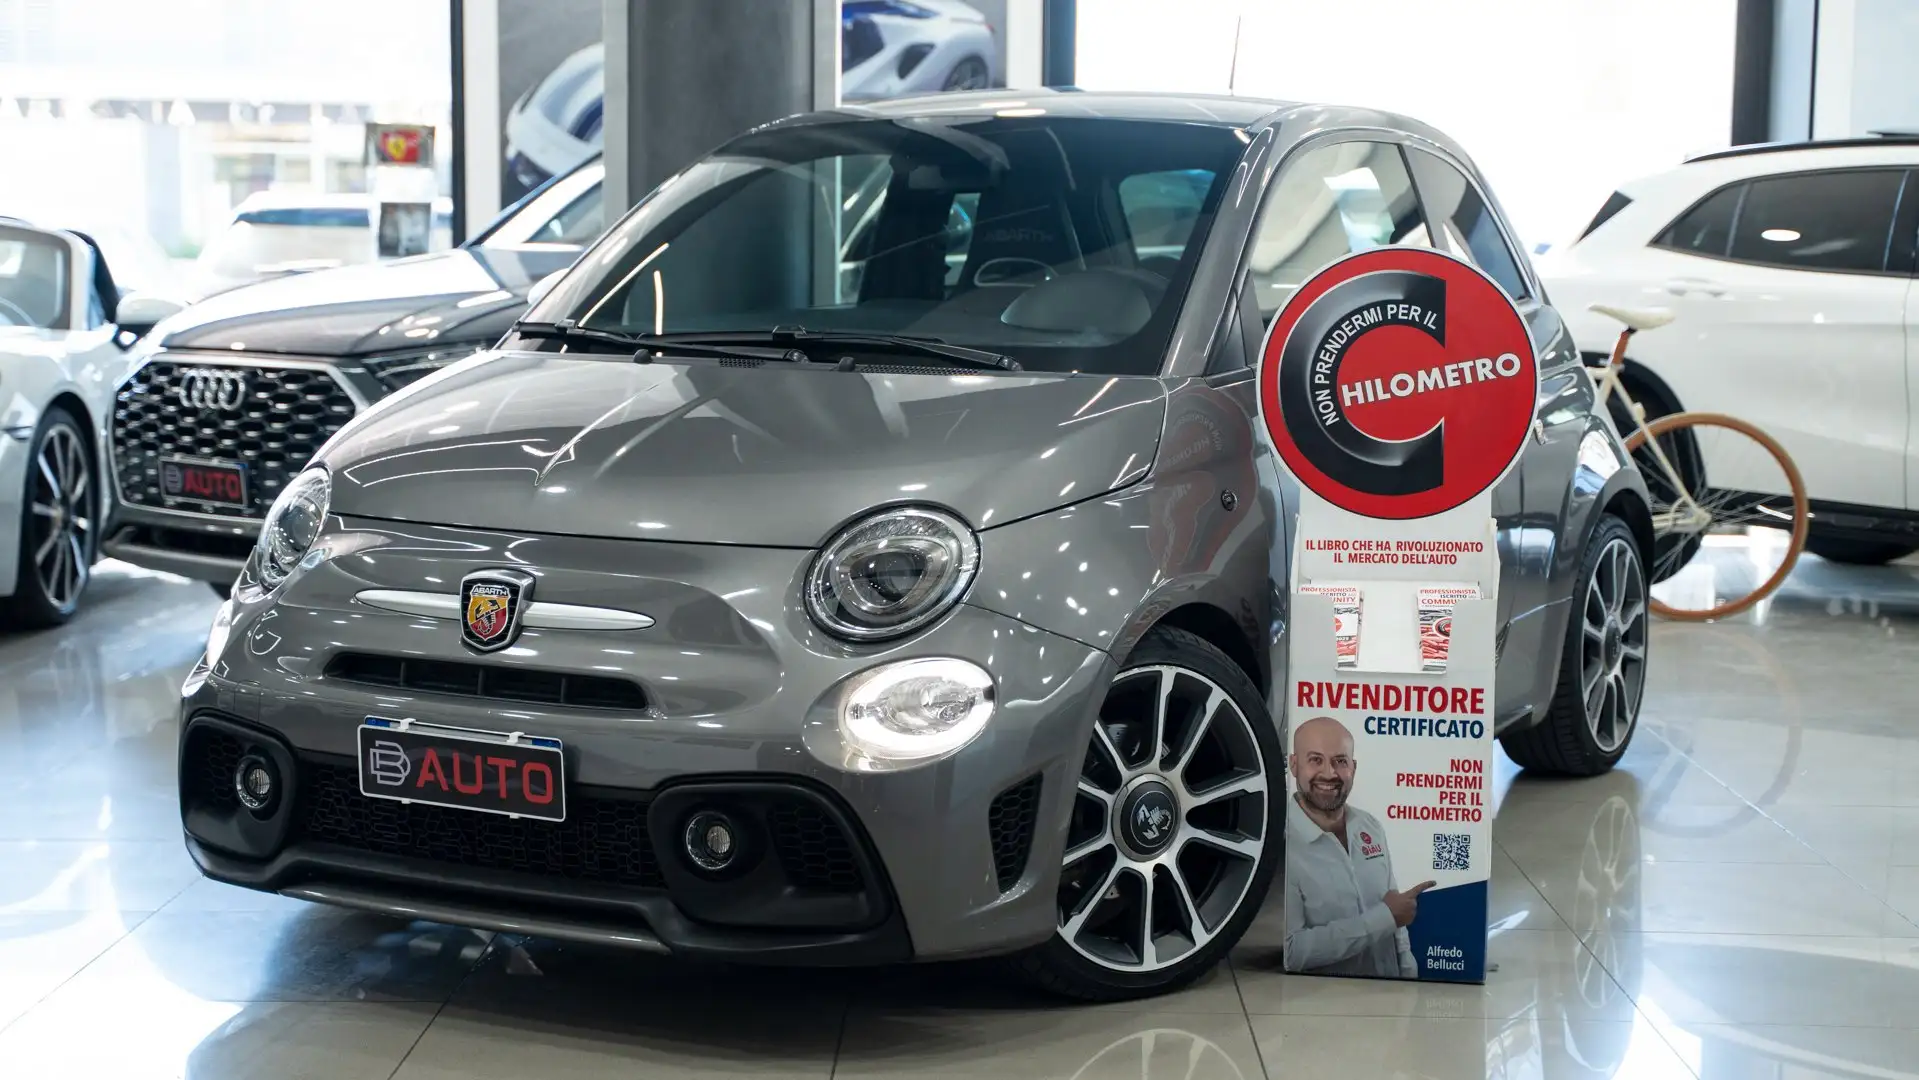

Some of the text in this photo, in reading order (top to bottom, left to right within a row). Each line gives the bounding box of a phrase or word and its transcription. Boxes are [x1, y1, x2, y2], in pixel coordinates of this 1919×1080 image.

[1315, 304, 1438, 426] NON PRENDERMI PER IL
[1341, 353, 1521, 406] HILOMETRO
[1306, 540, 1484, 553] IL LIBRO CHE HA RIVOLUZIONATO
[1334, 553, 1457, 565] IL MERCATO DELL'AUTO
[472, 587, 507, 596] ABARTH
[1297, 681, 1485, 714] RIVENDITORE
[1364, 716, 1484, 739] CERTIFICATO
[1450, 759, 1483, 773] NON
[416, 747, 554, 804] AUTO
[1396, 773, 1483, 789] PRENDERMI
[1439, 791, 1483, 806] PER IL
[1387, 805, 1482, 822] CHILOMETRO
[1427, 946, 1463, 958] Alfredo
[1427, 958, 1464, 971] Bellucci
